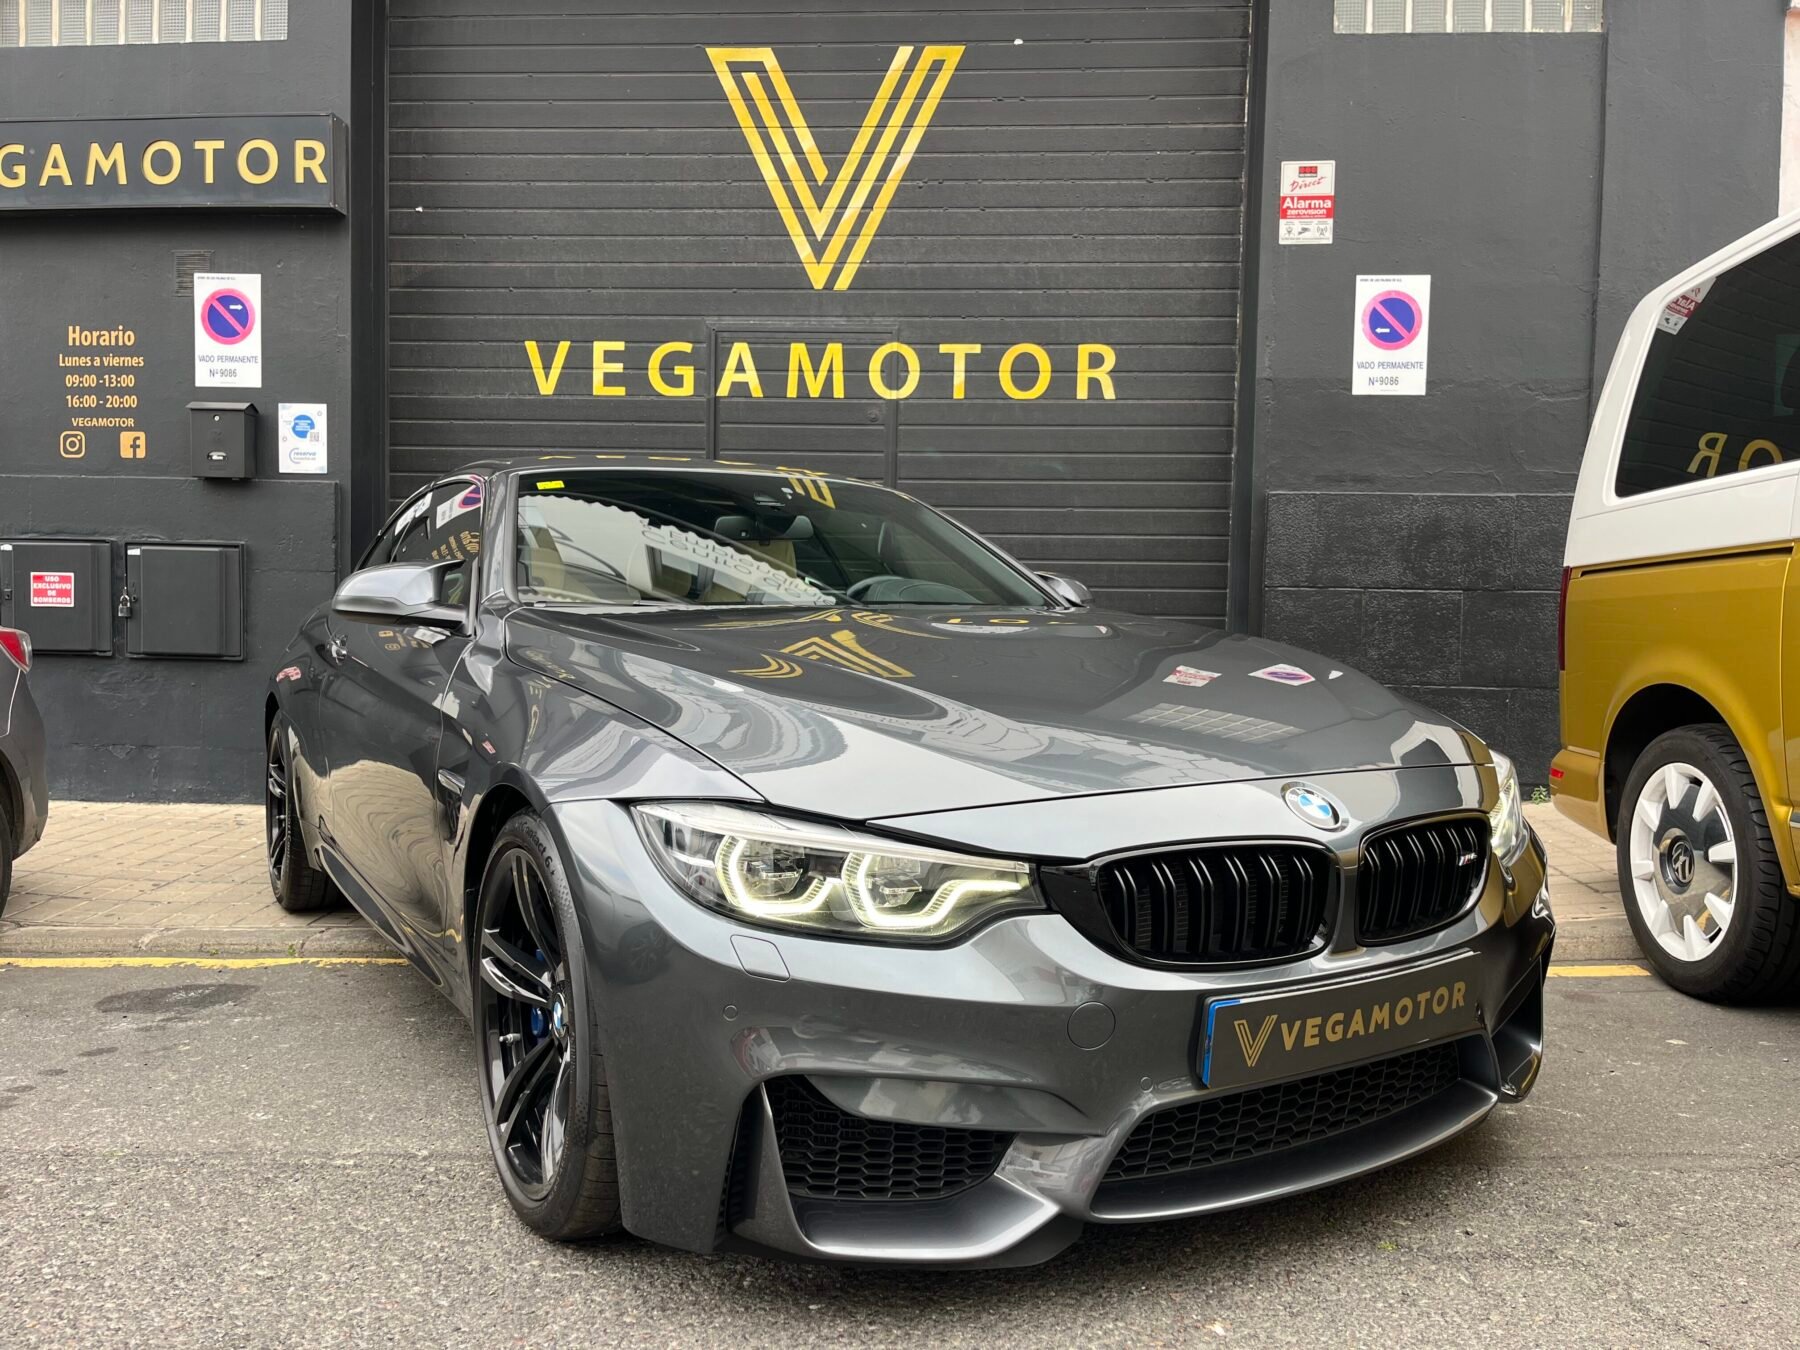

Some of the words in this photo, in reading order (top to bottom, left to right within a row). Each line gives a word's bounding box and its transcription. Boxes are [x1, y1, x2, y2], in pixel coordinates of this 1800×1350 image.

[0, 138, 328, 188] GAMOTOR
[1283, 196, 1332, 209] Alarma
[68, 325, 135, 346] Horario
[59, 353, 92, 367] Lunes
[93, 356, 101, 367] a
[103, 353, 145, 367] viernes
[198, 355, 215, 363] VADO
[217, 355, 259, 364] PERMANENTE
[1356, 361, 1375, 370] VADO
[1377, 361, 1424, 370] PERMANENTE
[524, 340, 1117, 400] VEGAMOTOR
[65, 374, 97, 387] 09:00
[65, 395, 97, 408] 16:00
[105, 395, 138, 408] 20:00
[71, 417, 135, 428] VEGAMOTOR
[33, 596, 71, 604] BOMBEROS
[1280, 981, 1466, 1051] VEGAMOTOR
